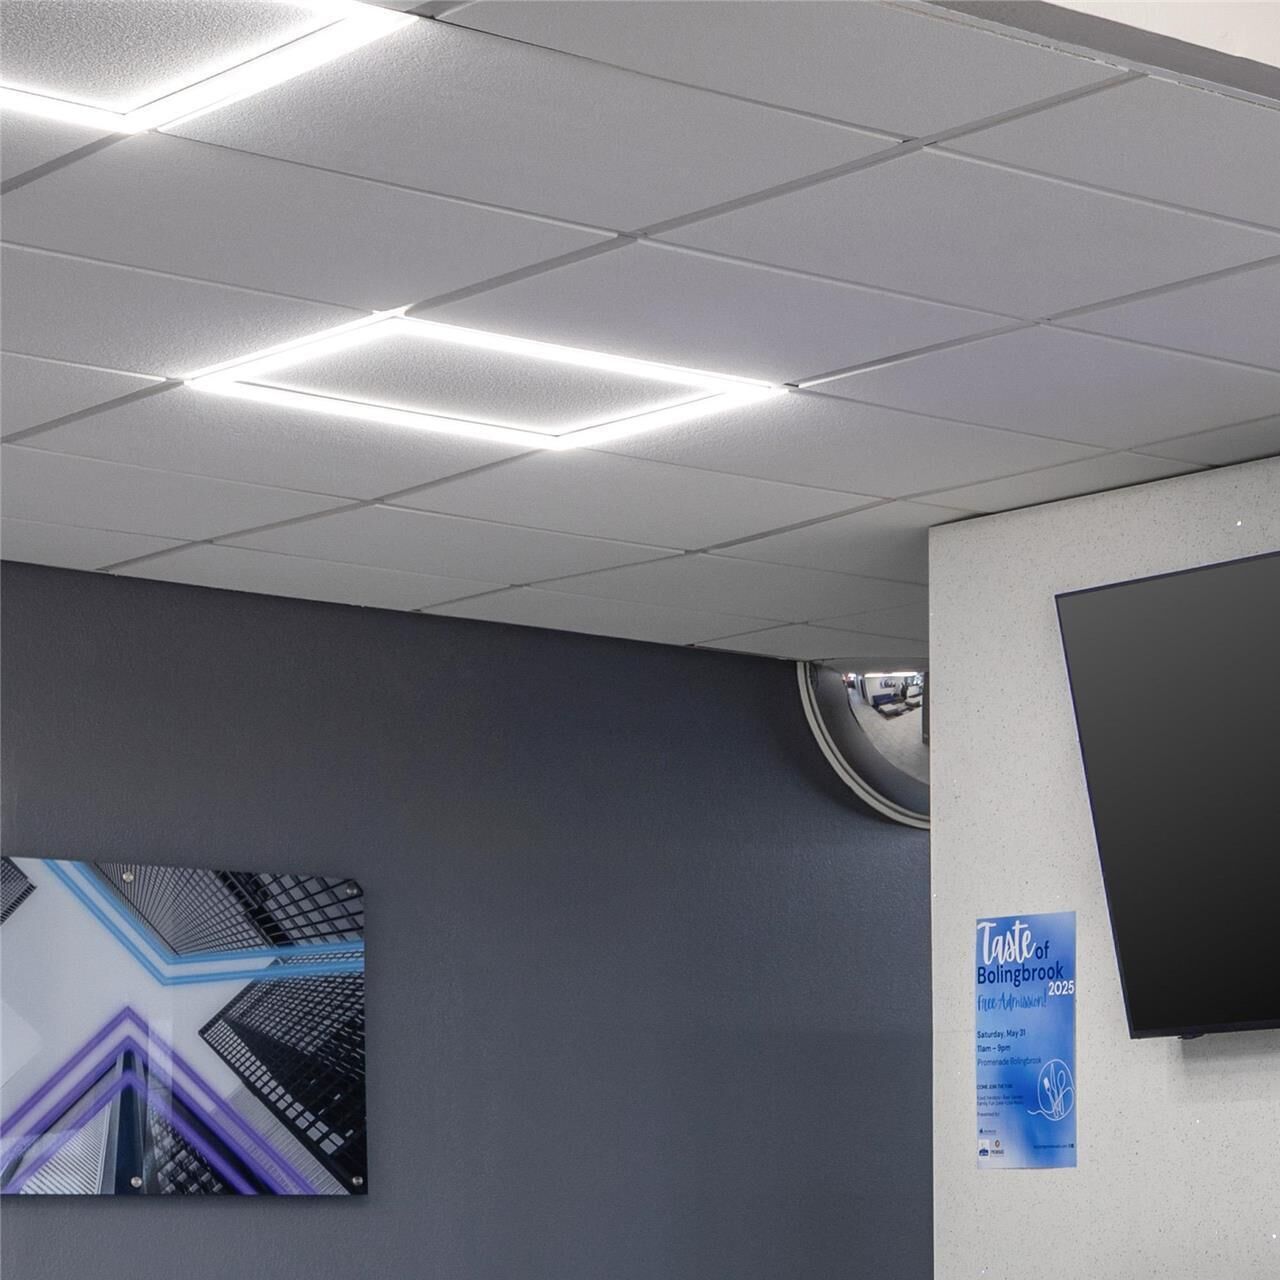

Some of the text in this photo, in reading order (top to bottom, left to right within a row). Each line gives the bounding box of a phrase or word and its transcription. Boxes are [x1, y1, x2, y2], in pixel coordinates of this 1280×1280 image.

[977, 919, 1050, 965] Taste of
[977, 961, 1064, 988] Bolingbrook
[1048, 980, 1075, 996] 2025
